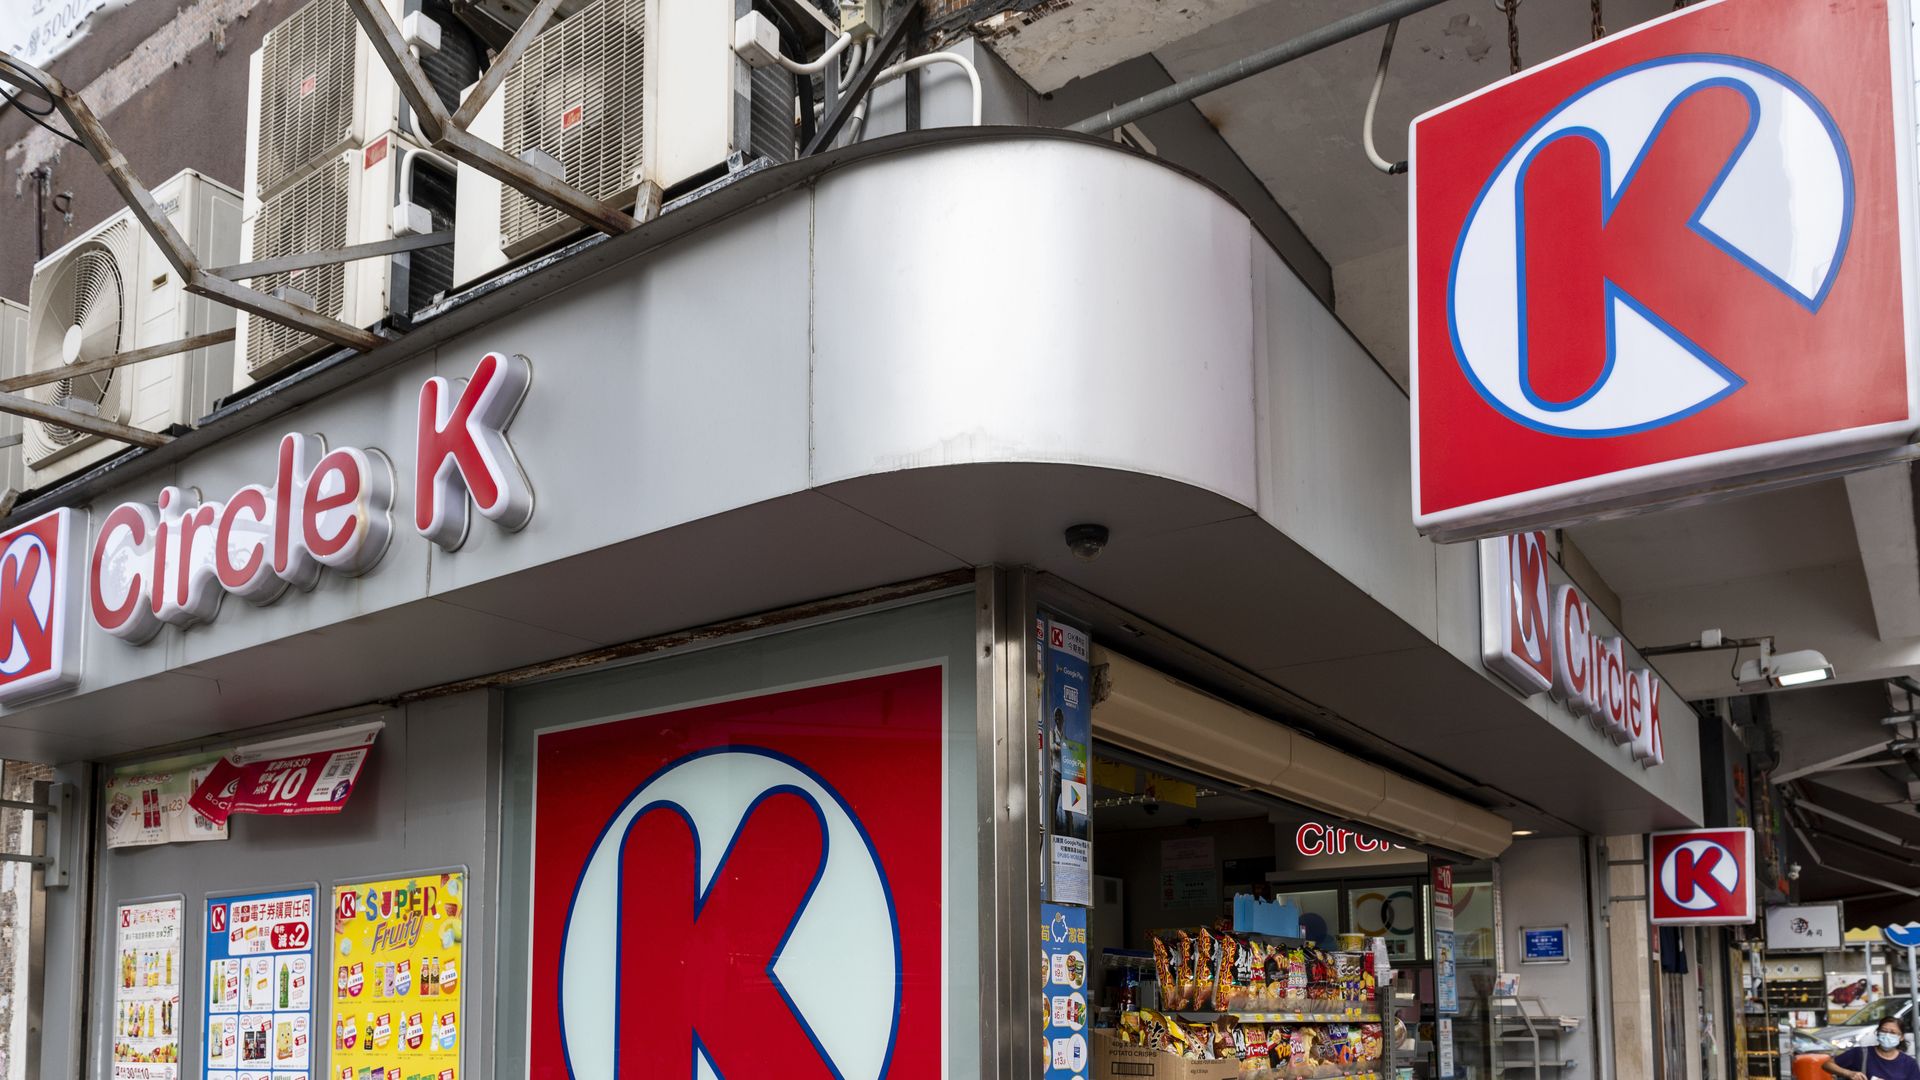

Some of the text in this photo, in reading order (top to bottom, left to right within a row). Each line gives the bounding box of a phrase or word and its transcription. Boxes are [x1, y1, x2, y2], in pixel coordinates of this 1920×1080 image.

[90, 354, 500, 631] Circle K
[1565, 588, 1664, 763] Circle K
[268, 767, 308, 801] 10
[1296, 822, 1406, 857] Circ
[366, 885, 438, 921] SUPER
[371, 911, 423, 954] Fruity
[1134, 1050, 1157, 1058] CRISPS
